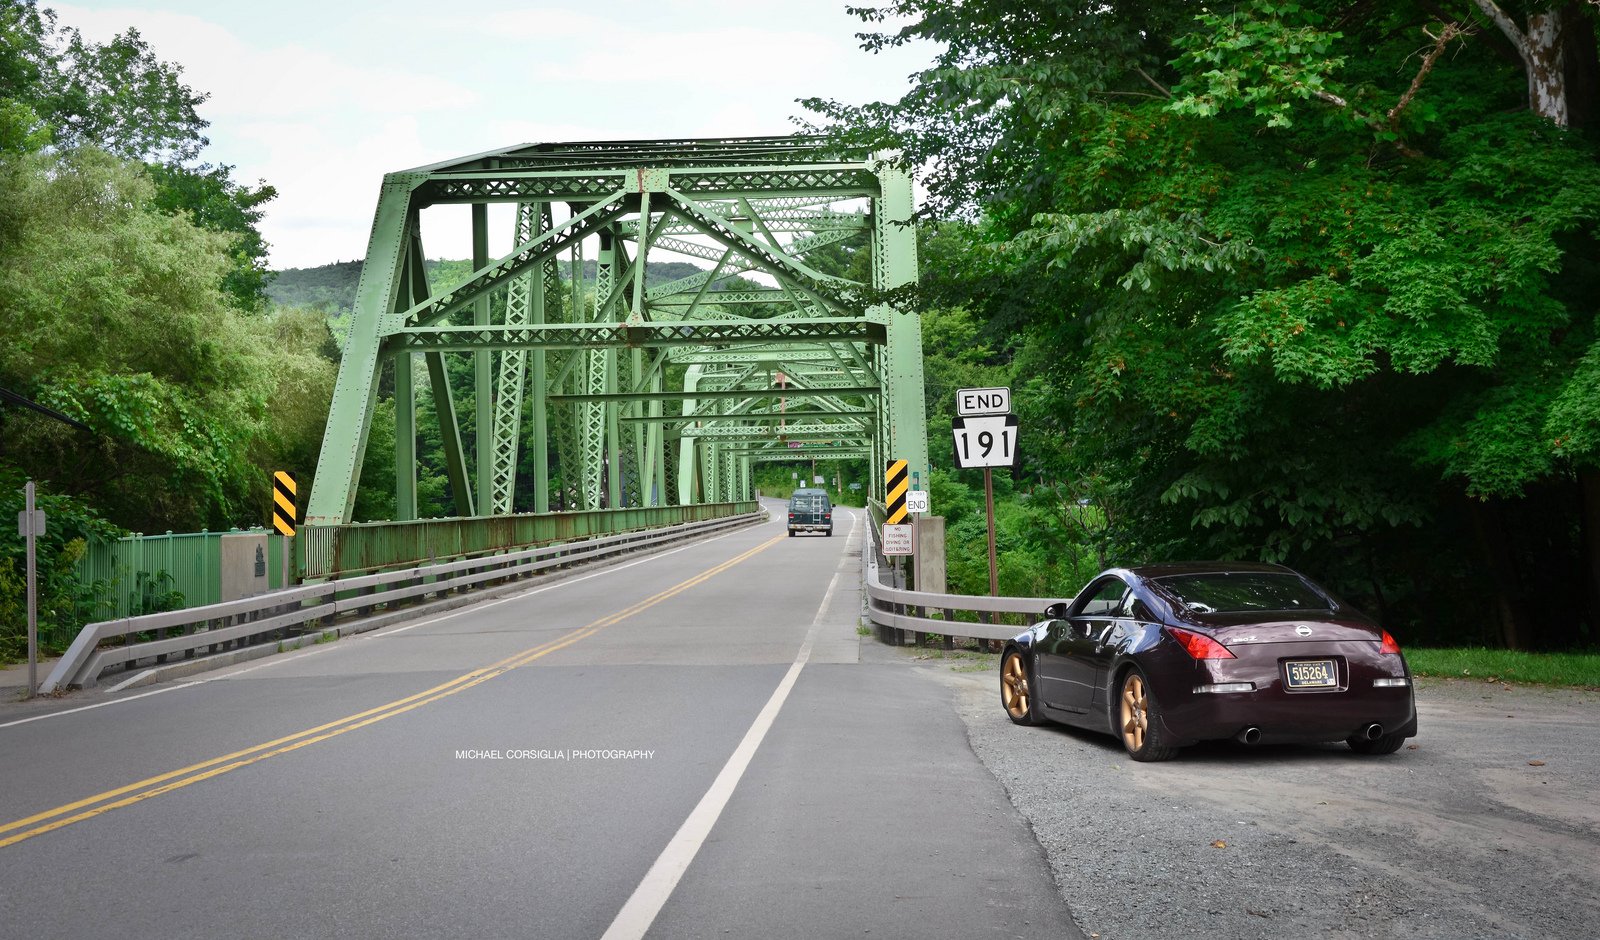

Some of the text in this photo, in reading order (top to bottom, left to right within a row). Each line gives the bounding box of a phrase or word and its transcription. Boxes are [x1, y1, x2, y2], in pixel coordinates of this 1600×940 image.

[964, 394, 1003, 409] END
[961, 431, 1009, 459] 191
[908, 500, 926, 510] END
[1292, 666, 1329, 680] 515264
